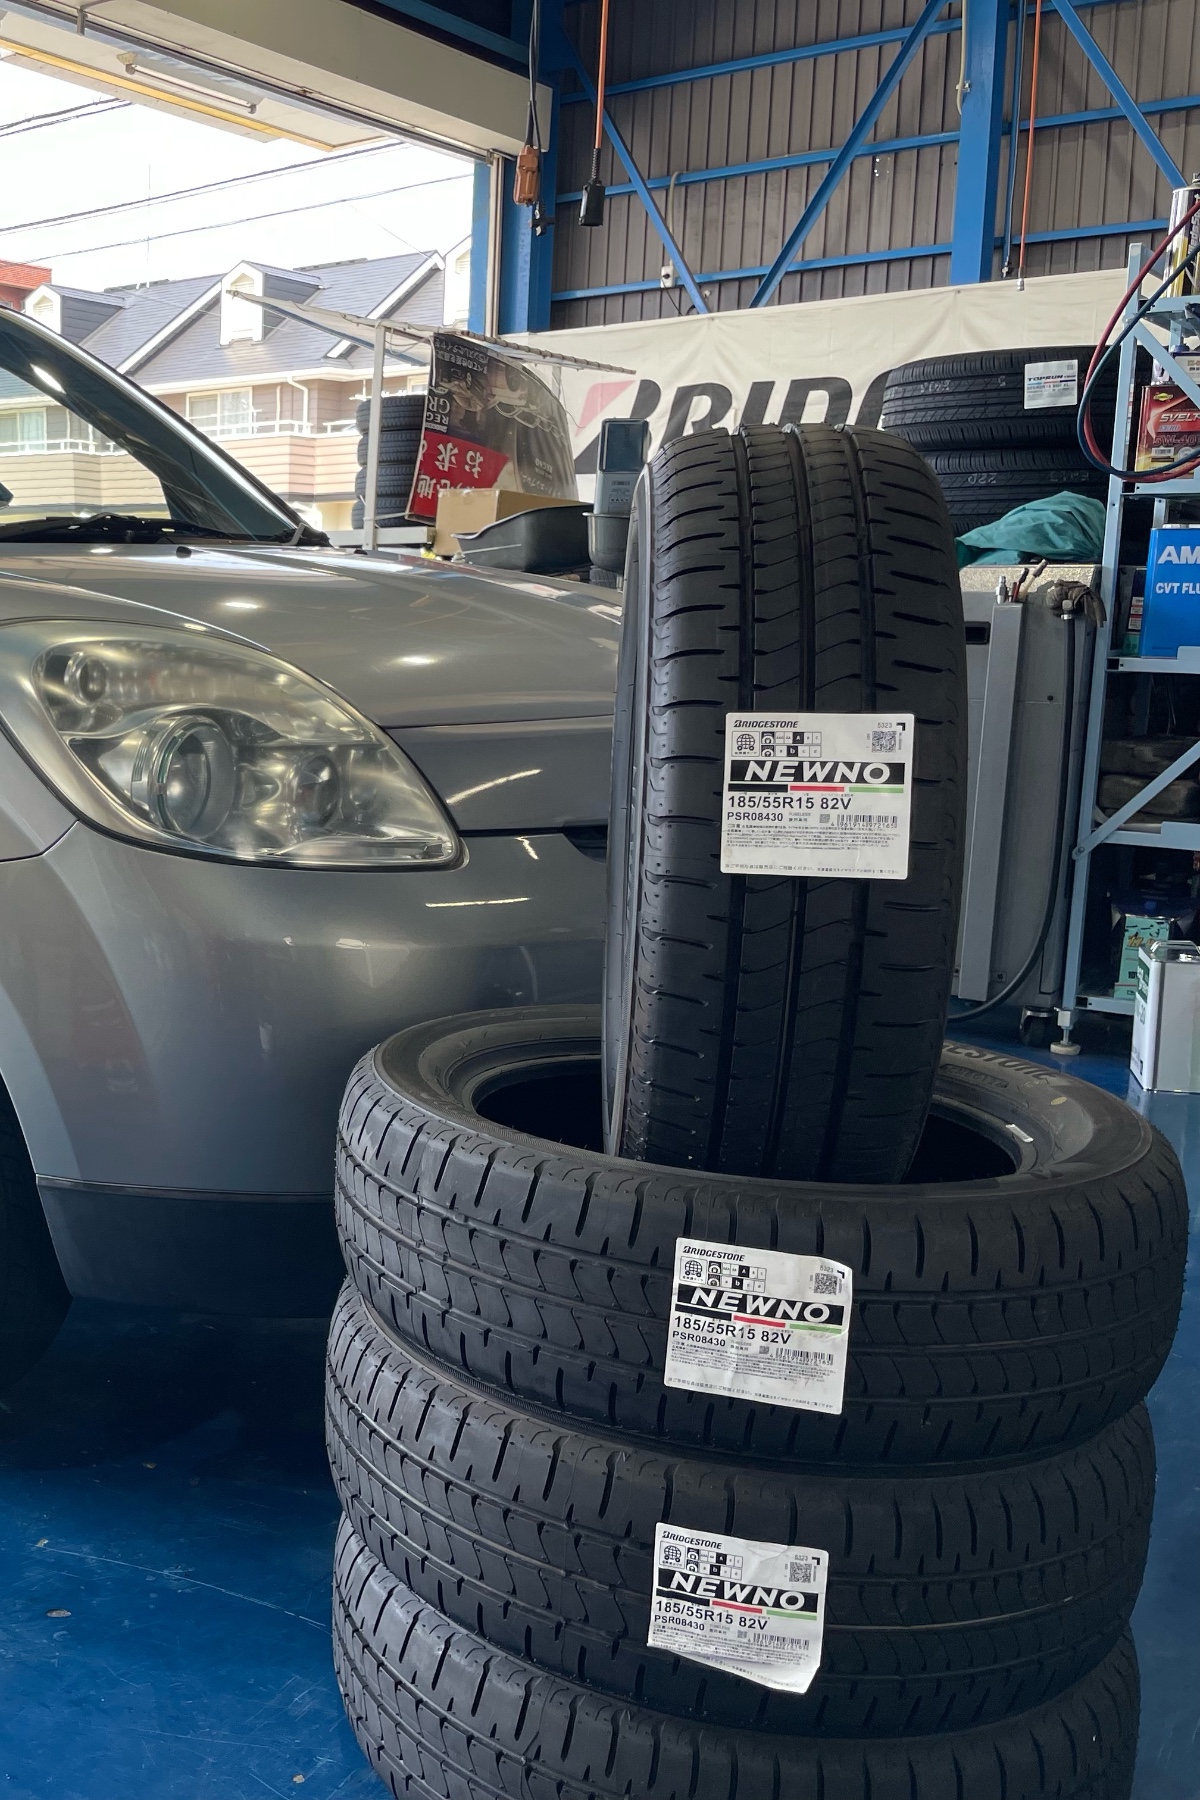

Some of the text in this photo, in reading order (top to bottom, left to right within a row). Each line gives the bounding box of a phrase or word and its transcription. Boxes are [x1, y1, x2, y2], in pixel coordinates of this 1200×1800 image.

[1155, 583, 1180, 594] CVT
[733, 720, 799, 728] BRIDGESTONE
[744, 761, 890, 784] NEWNO
[728, 796, 852, 810] 185/55R15 82V
[727, 811, 783, 822] PSR08430
[682, 1245, 745, 1262] BRIDGESTONE
[690, 1287, 830, 1323] NEWNO
[672, 1330, 726, 1347] PSR08430
[675, 1316, 792, 1345] 185/55R15 82V
[662, 1530, 722, 1550] BRIDGESTONE
[669, 1571, 805, 1611] NEWNO
[654, 1614, 705, 1631] PSR08430
[656, 1601, 734, 1625] 185/55R15
[738, 1616, 768, 1630] 82V
